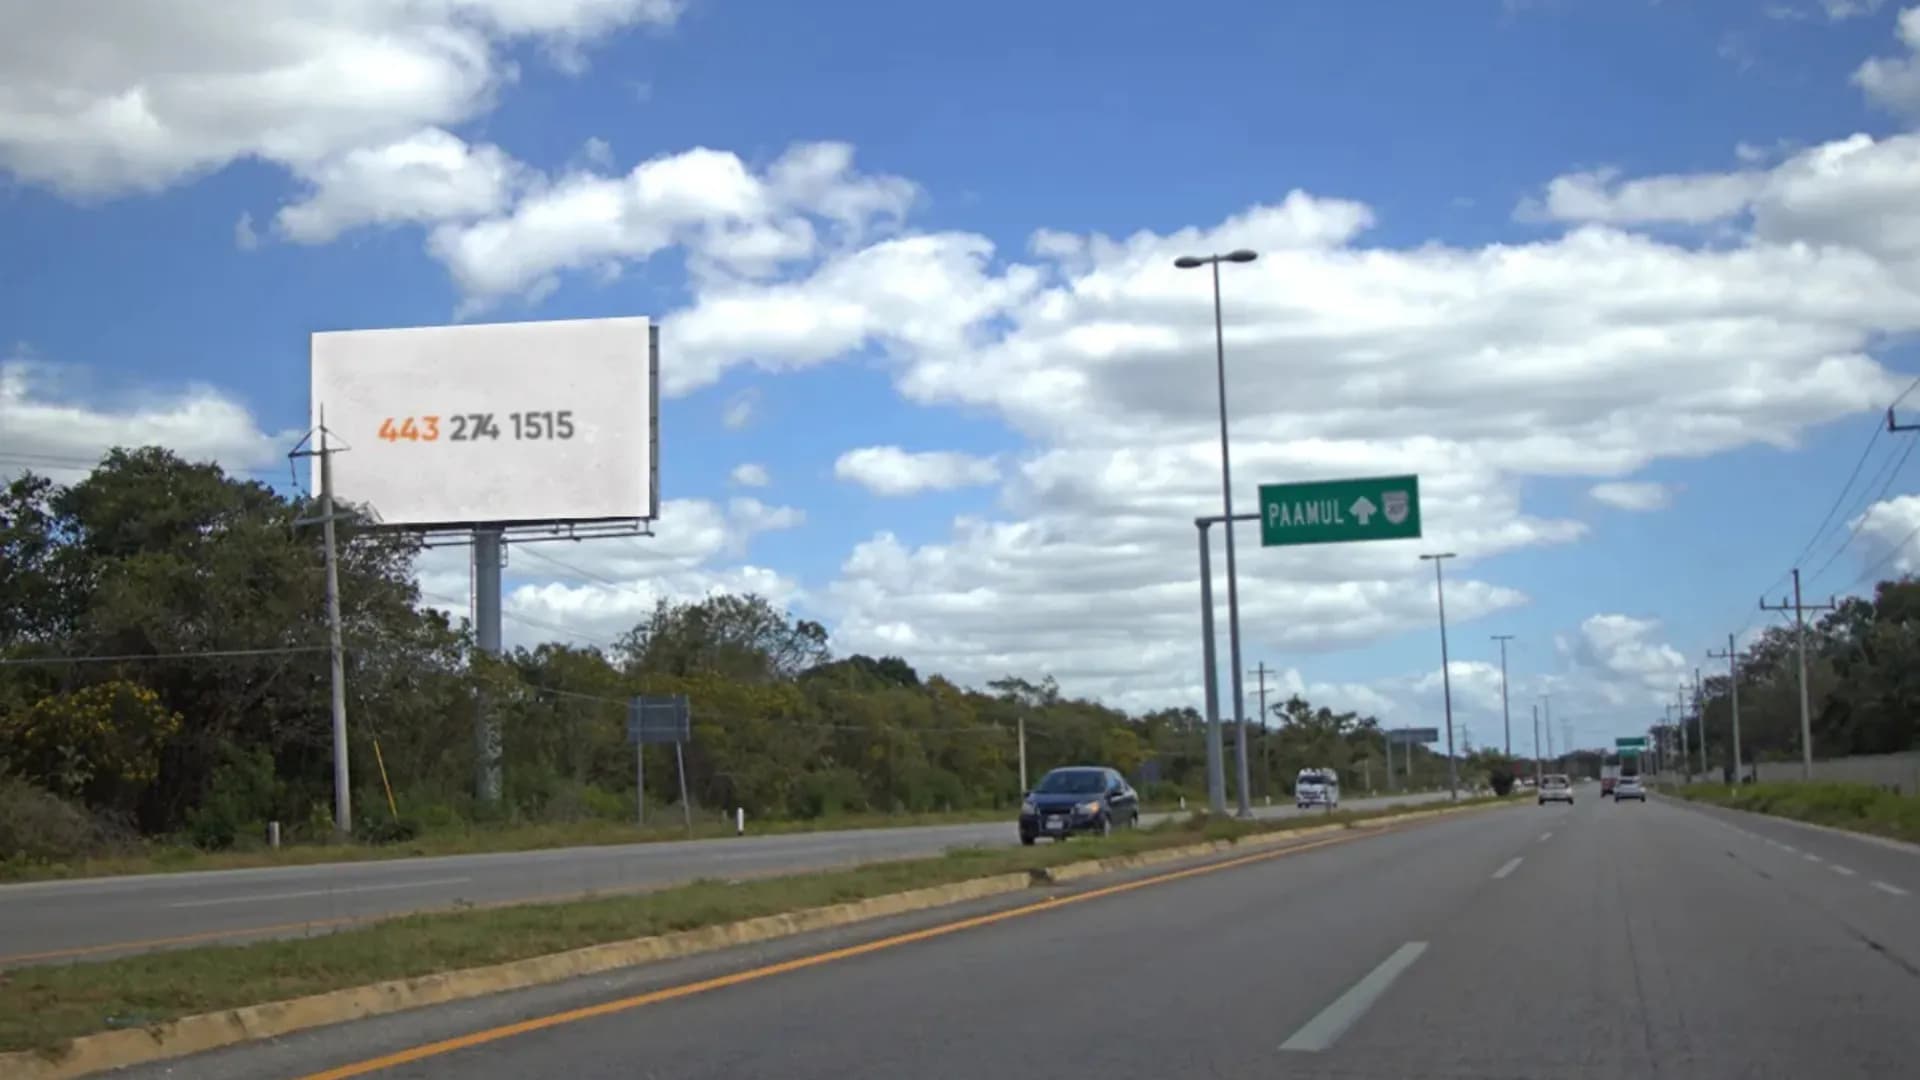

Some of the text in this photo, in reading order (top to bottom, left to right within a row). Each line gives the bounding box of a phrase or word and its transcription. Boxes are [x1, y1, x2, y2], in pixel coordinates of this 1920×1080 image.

[378, 411, 574, 442] 443 274 1515
[1268, 499, 1345, 528] PAAMUL
